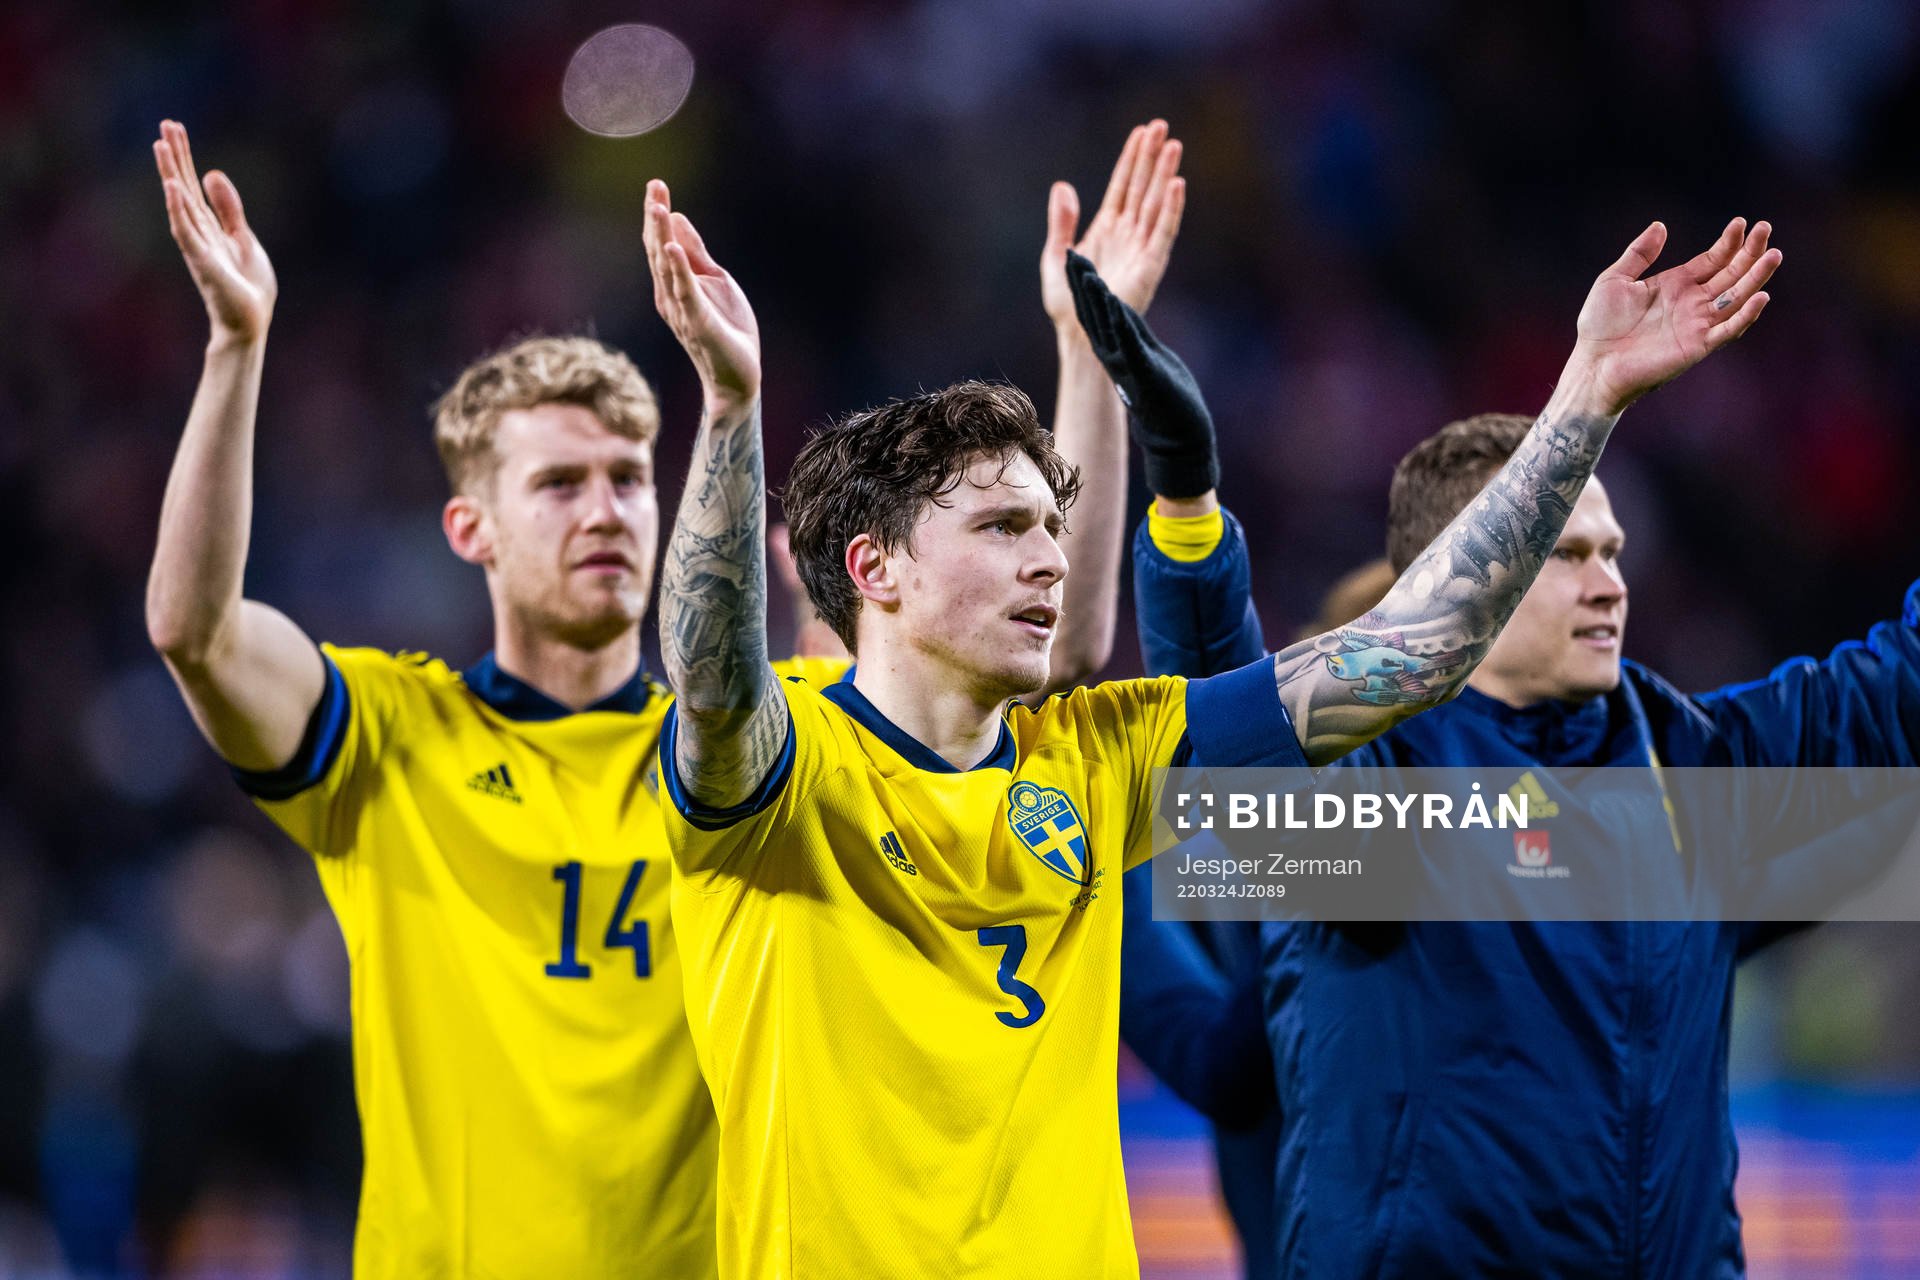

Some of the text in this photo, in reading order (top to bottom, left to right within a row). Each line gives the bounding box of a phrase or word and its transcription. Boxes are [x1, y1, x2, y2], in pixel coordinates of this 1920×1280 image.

[1022, 803, 1062, 830] SVERIGE
[544, 860, 652, 979] 14
[977, 924, 1046, 1028] 3
